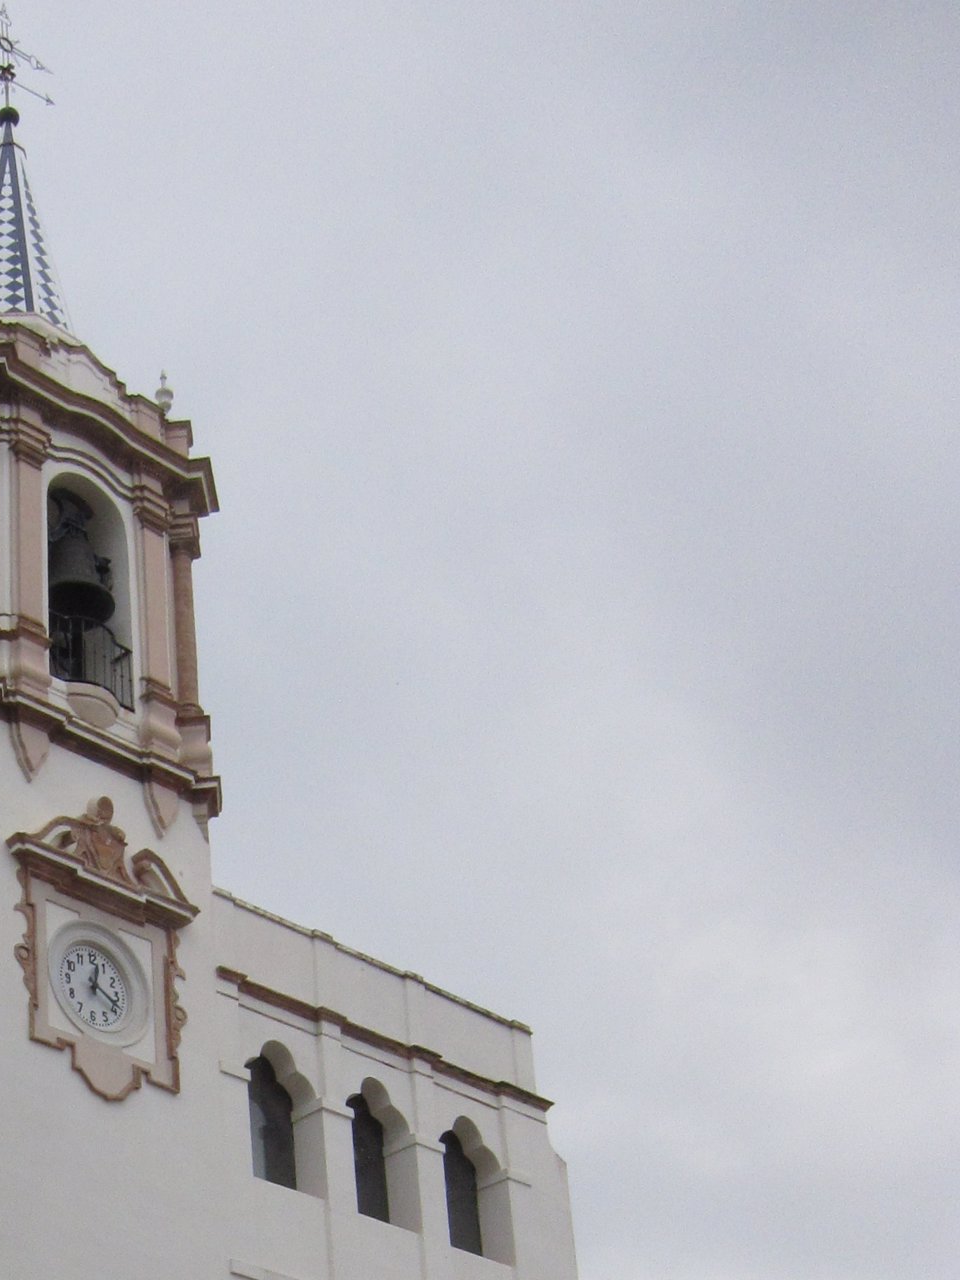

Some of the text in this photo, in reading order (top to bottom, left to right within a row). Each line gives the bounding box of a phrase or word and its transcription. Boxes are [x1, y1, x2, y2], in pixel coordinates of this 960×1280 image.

[76, 954, 84, 965] 11
[88, 952, 96, 966] 12
[66, 960, 76, 972] 10
[102, 964, 106, 974] 1
[65, 973, 71, 984] 9
[110, 977, 116, 988] 2
[69, 988, 75, 999] 8
[114, 992, 120, 1002] 3
[77, 1002, 83, 1013] 7
[110, 1004, 118, 1016] 4
[90, 1010, 96, 1021] 6
[102, 1011, 108, 1022] 5
